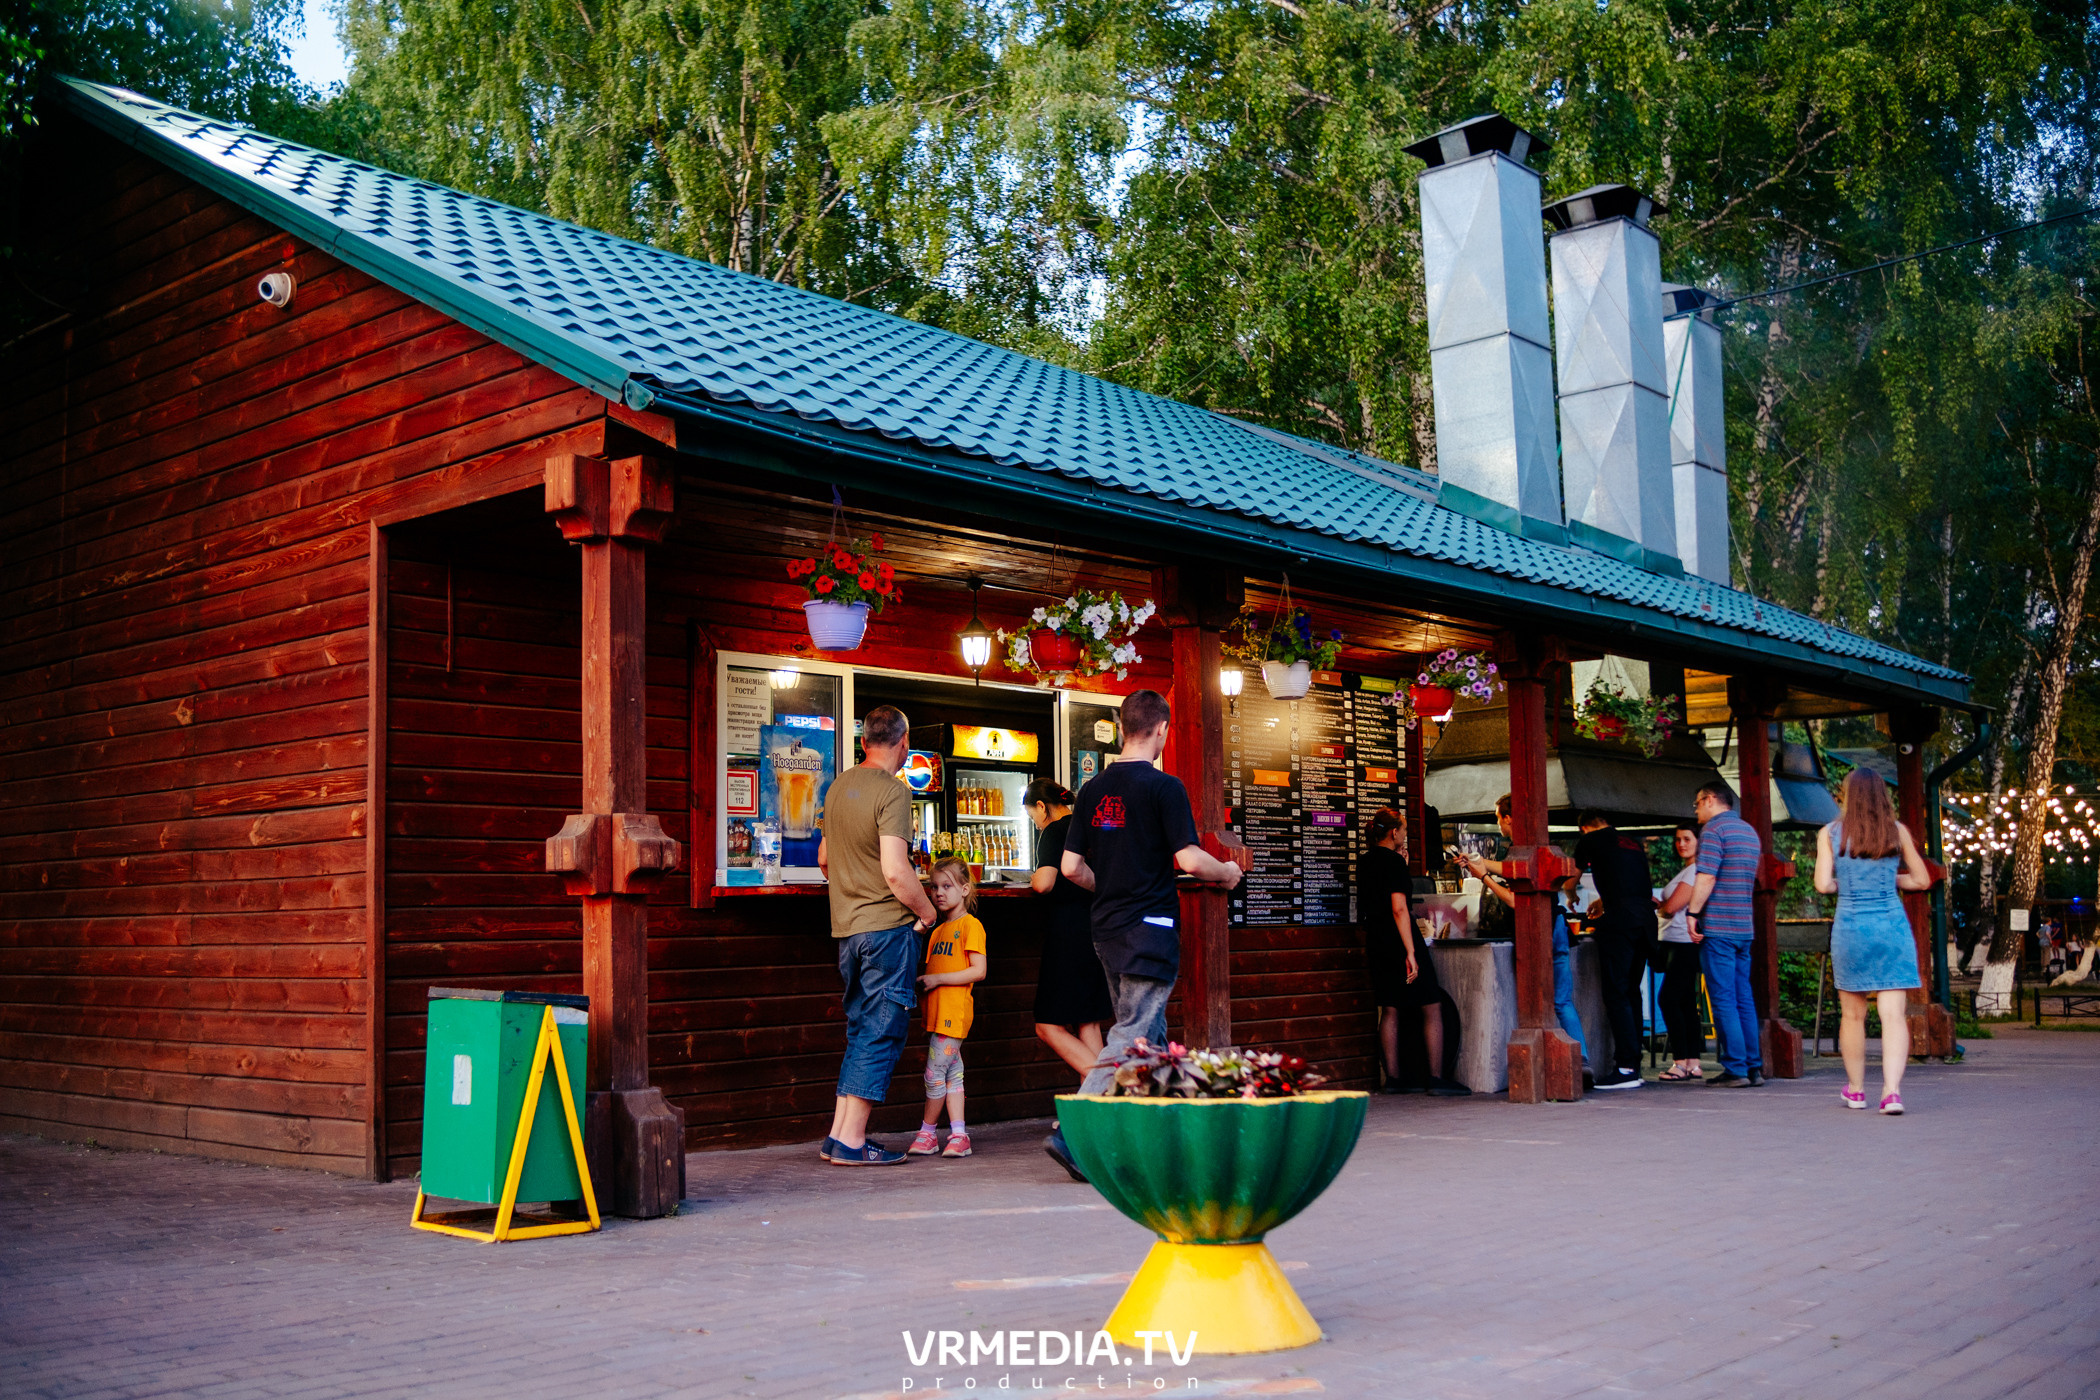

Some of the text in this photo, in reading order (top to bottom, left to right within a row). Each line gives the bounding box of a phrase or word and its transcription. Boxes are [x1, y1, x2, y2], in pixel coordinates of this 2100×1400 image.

[727, 673, 767, 686] Уважаемые
[735, 686, 757, 696] гости!
[785, 715, 821, 729] PEPSI
[772, 752, 823, 772] Hoegaarden
[728, 826, 749, 835] КАФЕ
[944, 1019, 951, 1028] 10
